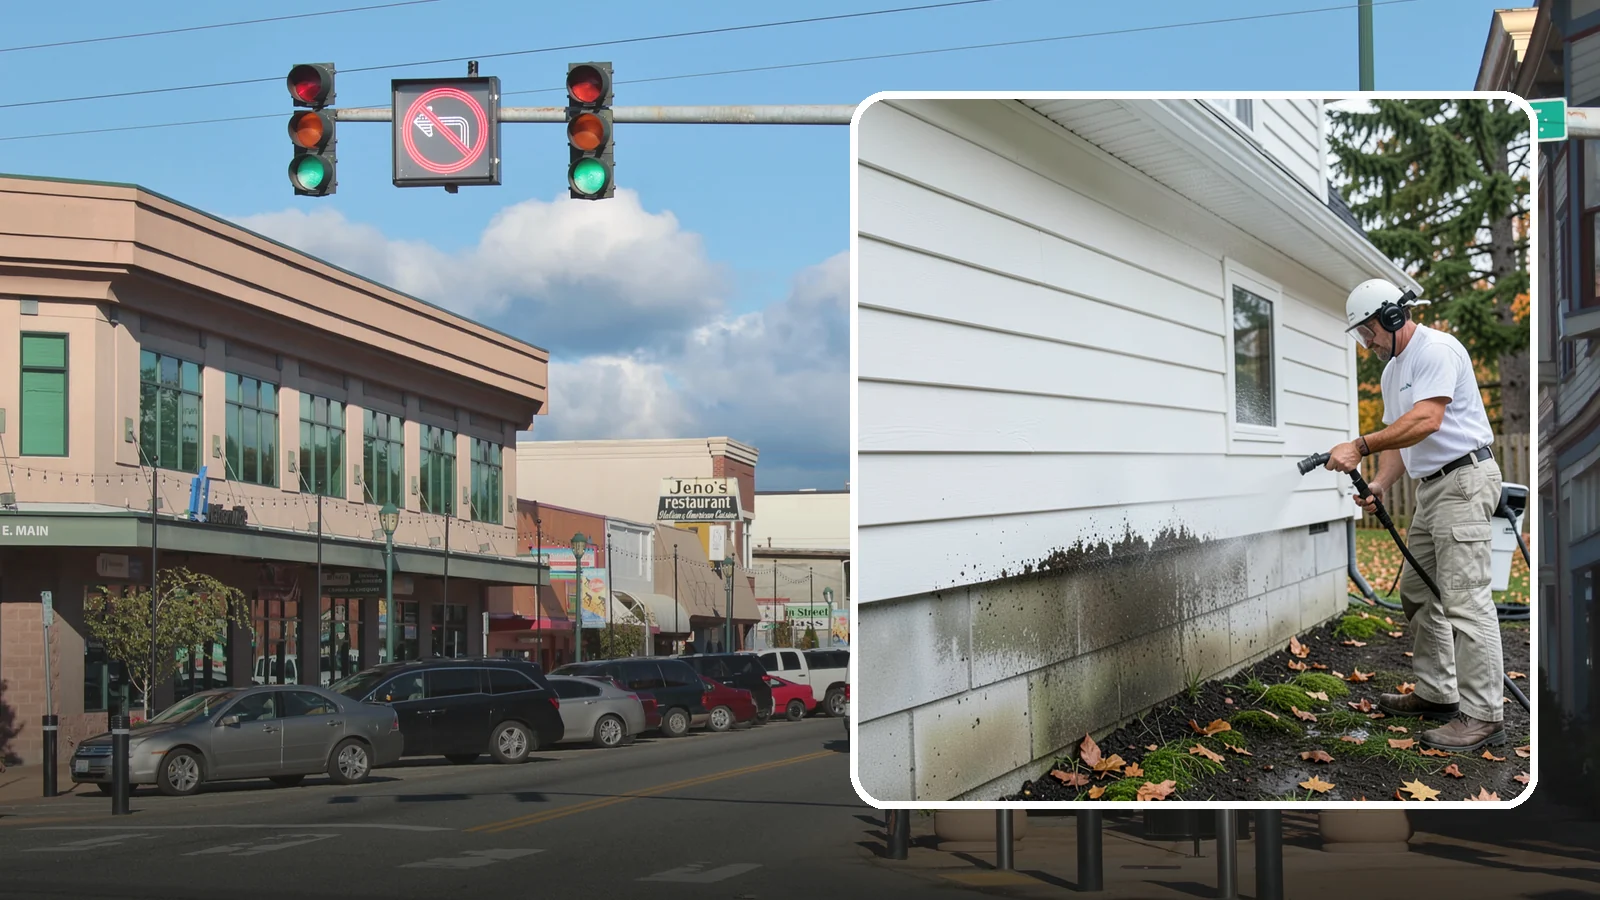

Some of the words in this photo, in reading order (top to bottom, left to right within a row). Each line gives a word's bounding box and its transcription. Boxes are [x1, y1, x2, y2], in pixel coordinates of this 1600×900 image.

[669, 480, 727, 494] Jeno's
[665, 496, 731, 509] restaurant
[686, 510, 715, 519] American
[715, 510, 738, 519] Cuisine
[2, 525, 13, 536] E.
[15, 525, 49, 536] MAIN
[797, 608, 828, 616] Street
[790, 619, 824, 627] lass
